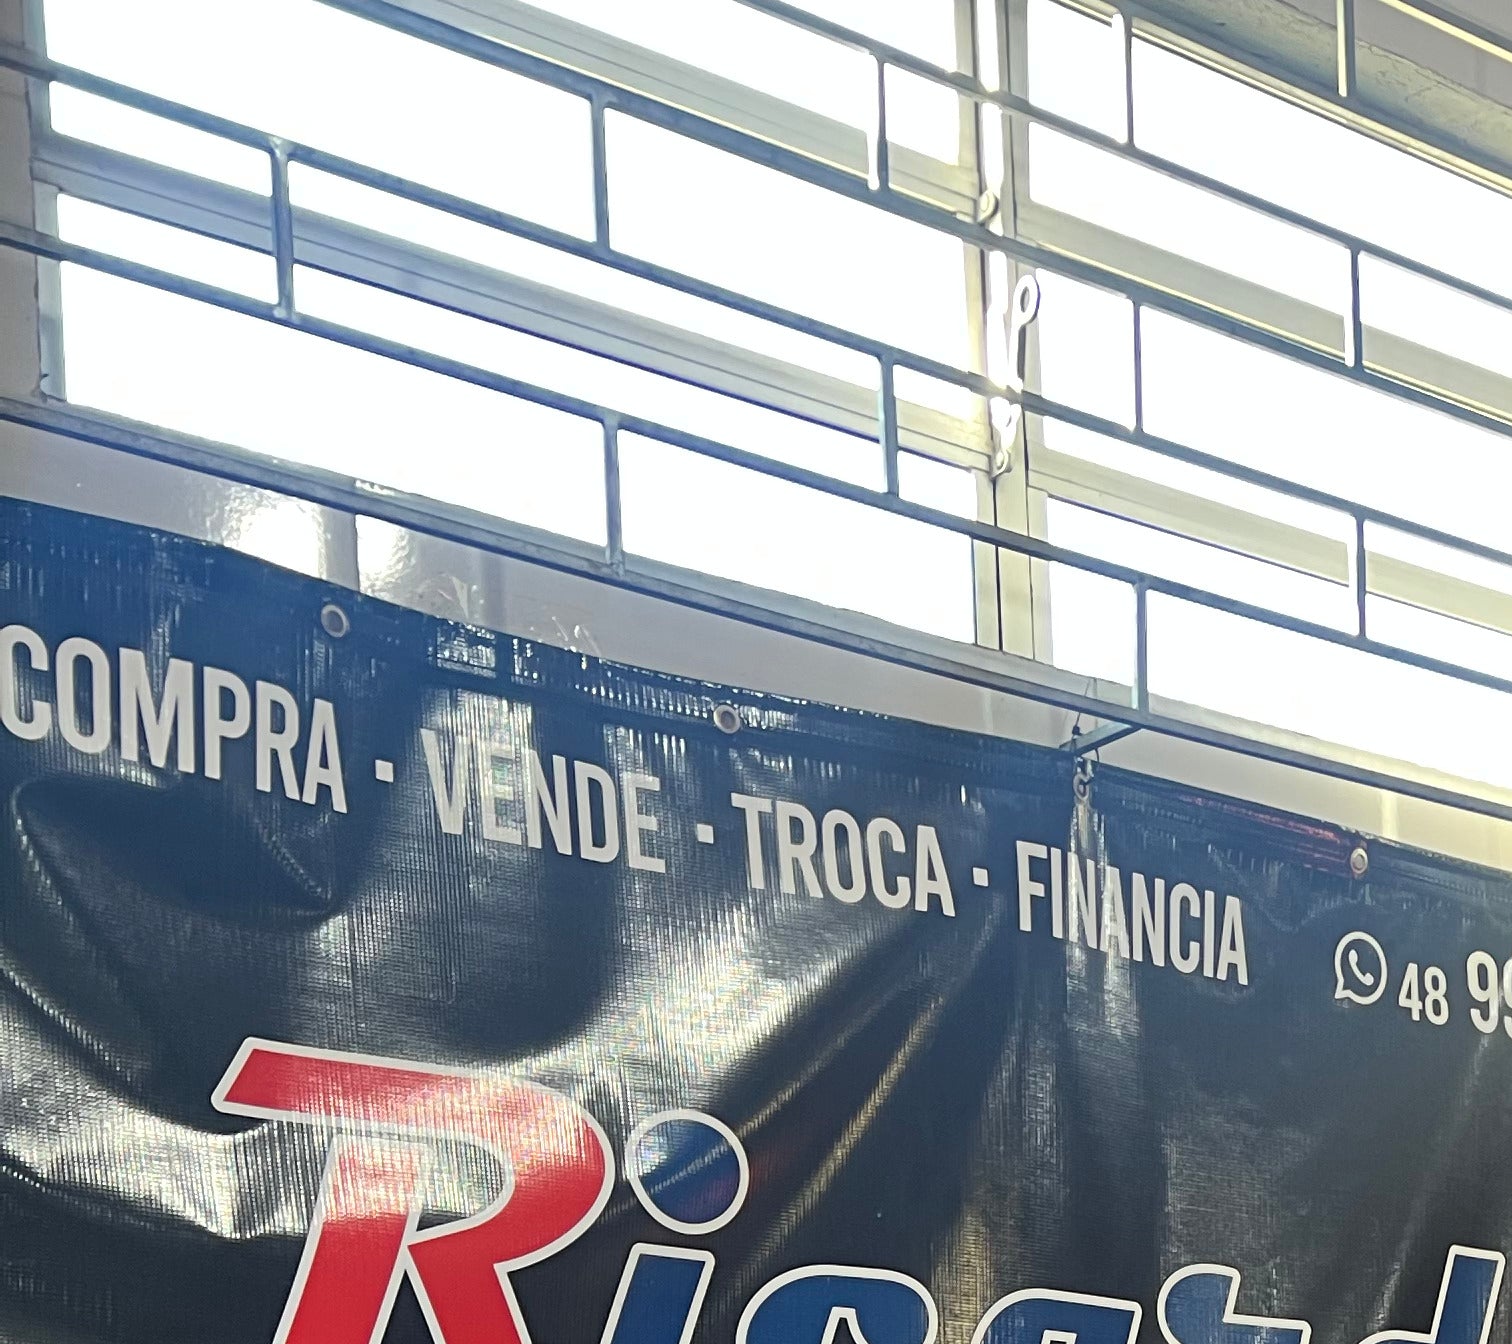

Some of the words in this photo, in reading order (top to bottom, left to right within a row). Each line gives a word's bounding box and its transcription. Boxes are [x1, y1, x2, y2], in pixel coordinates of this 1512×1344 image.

[0, 623, 348, 815] COMPRA
[420, 727, 667, 874] VENDE
[730, 792, 956, 918] TROCA
[1016, 838, 1250, 988] FINANCIA
[1398, 962, 1449, 1026] 48
